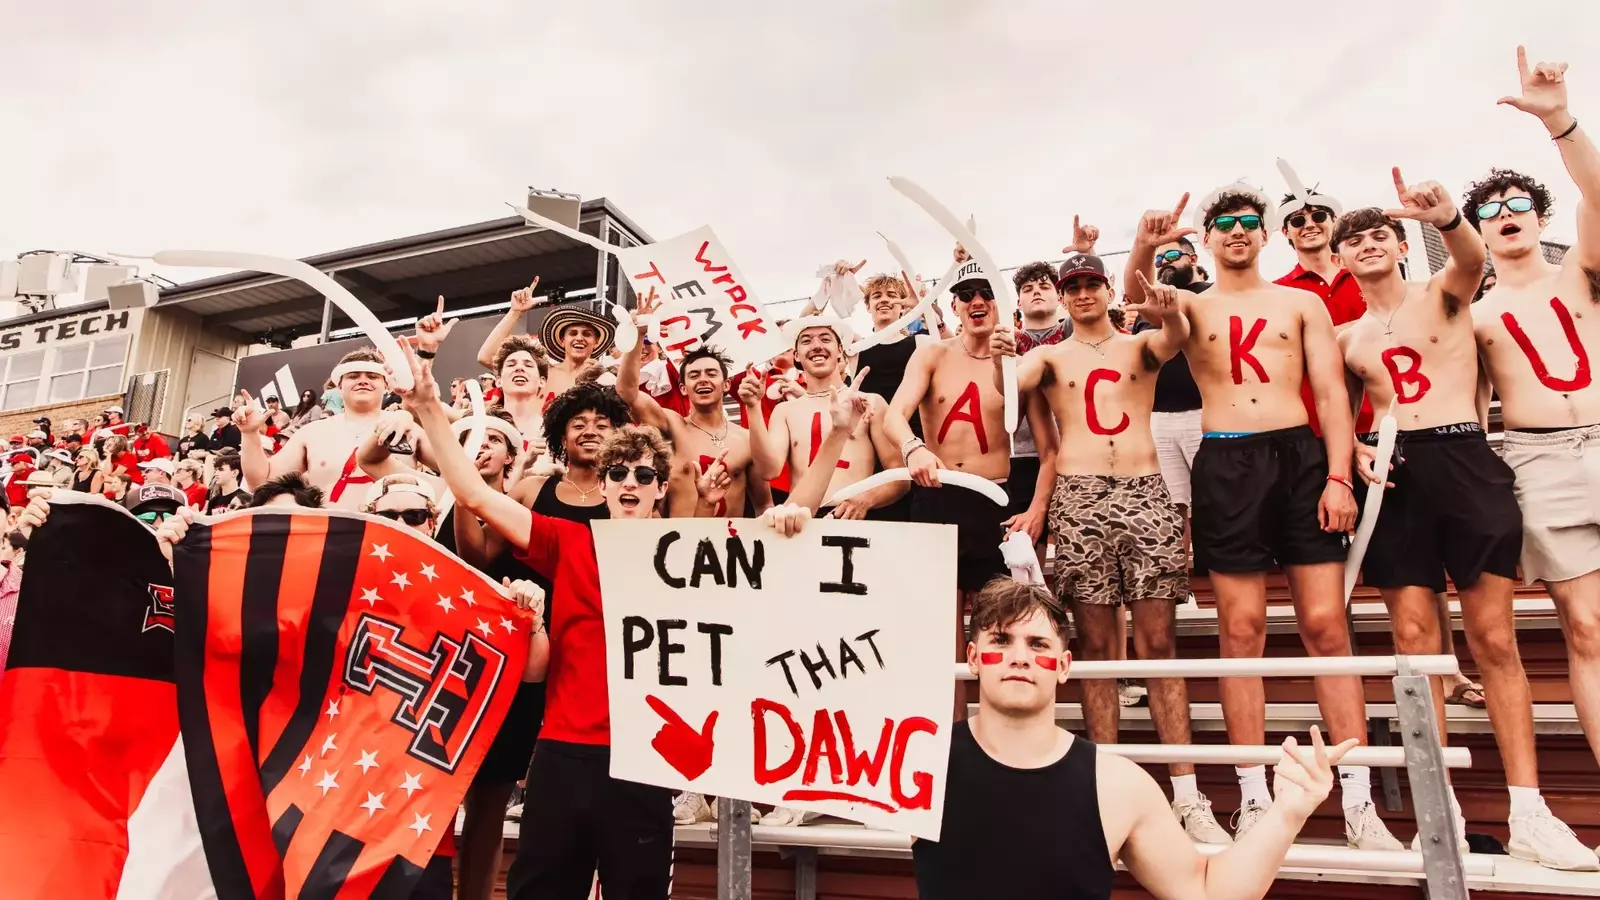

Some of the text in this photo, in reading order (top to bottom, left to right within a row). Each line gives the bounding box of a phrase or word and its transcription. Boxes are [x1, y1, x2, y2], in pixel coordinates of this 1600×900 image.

[0, 311, 129, 350] S TECH
[634, 261, 698, 362] TCH
[937, 381, 988, 455] A
[1084, 368, 1130, 436] C
[1229, 315, 1270, 385] K
[1381, 345, 1432, 405] B
[1500, 296, 1592, 392] U
[1435, 423, 1481, 435] HANE
[653, 530, 871, 596] CAN I
[622, 615, 886, 698] PET THAT
[751, 697, 939, 810] DAWG
